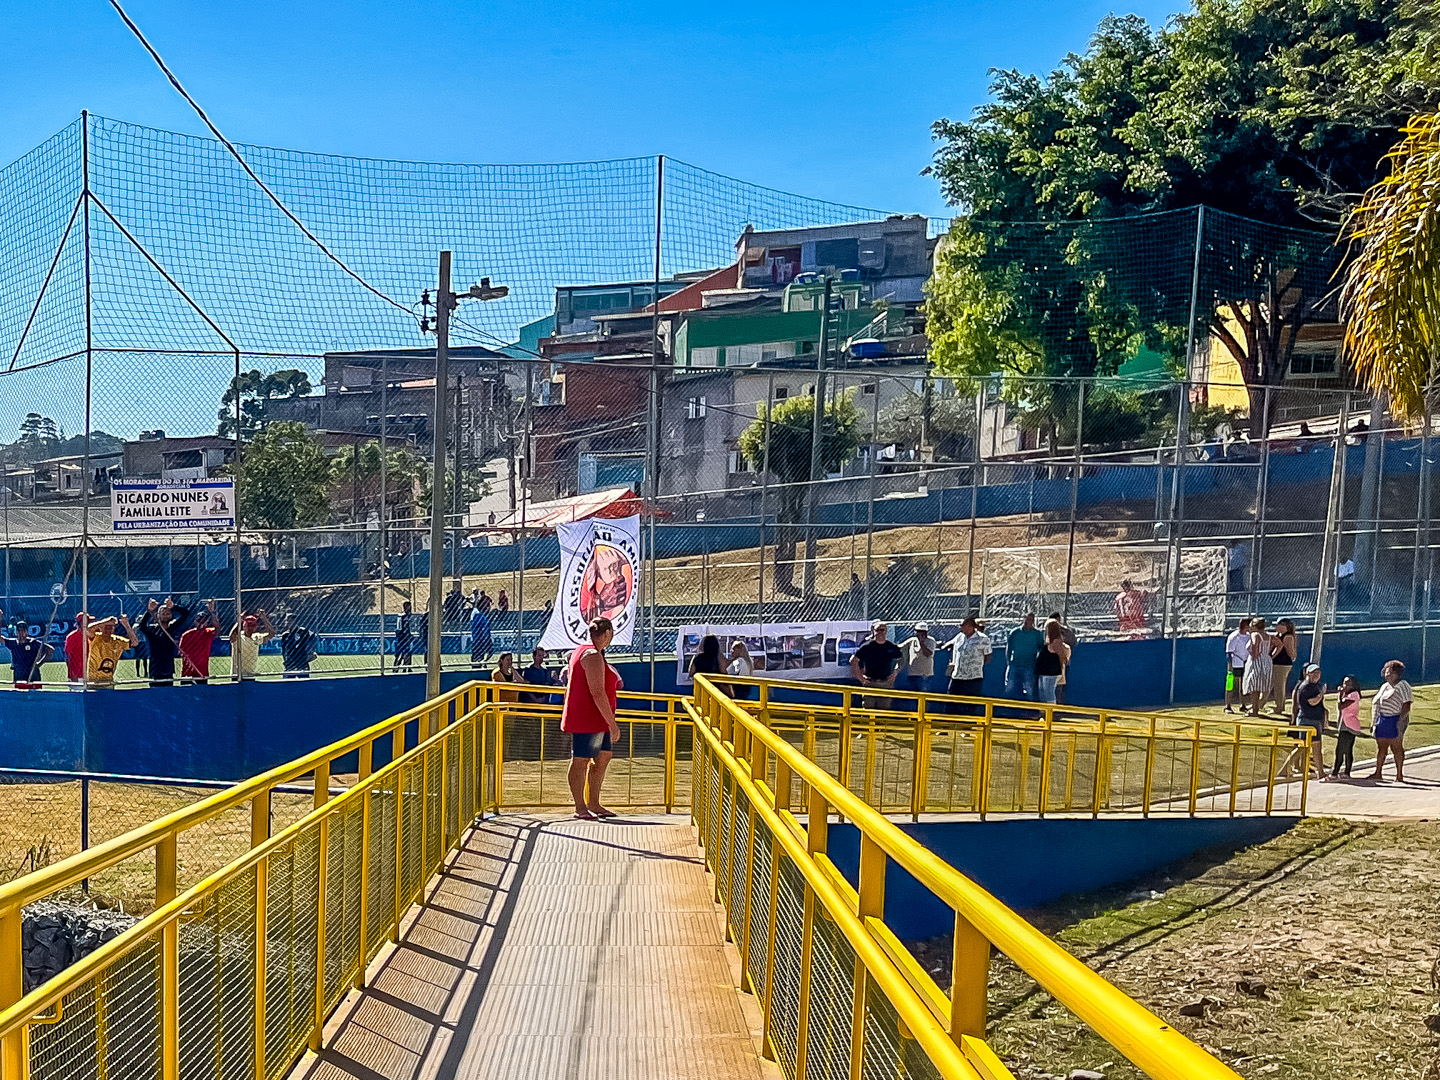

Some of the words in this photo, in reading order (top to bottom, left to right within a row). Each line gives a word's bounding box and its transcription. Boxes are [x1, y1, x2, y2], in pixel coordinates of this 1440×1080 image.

[117, 492, 169, 504] RICARDO
[172, 492, 209, 503] NUNES
[120, 505, 162, 517] FAMÍLIA
[165, 507, 191, 516] LEITE
[133, 520, 179, 530] URBANIZAÇÃO
